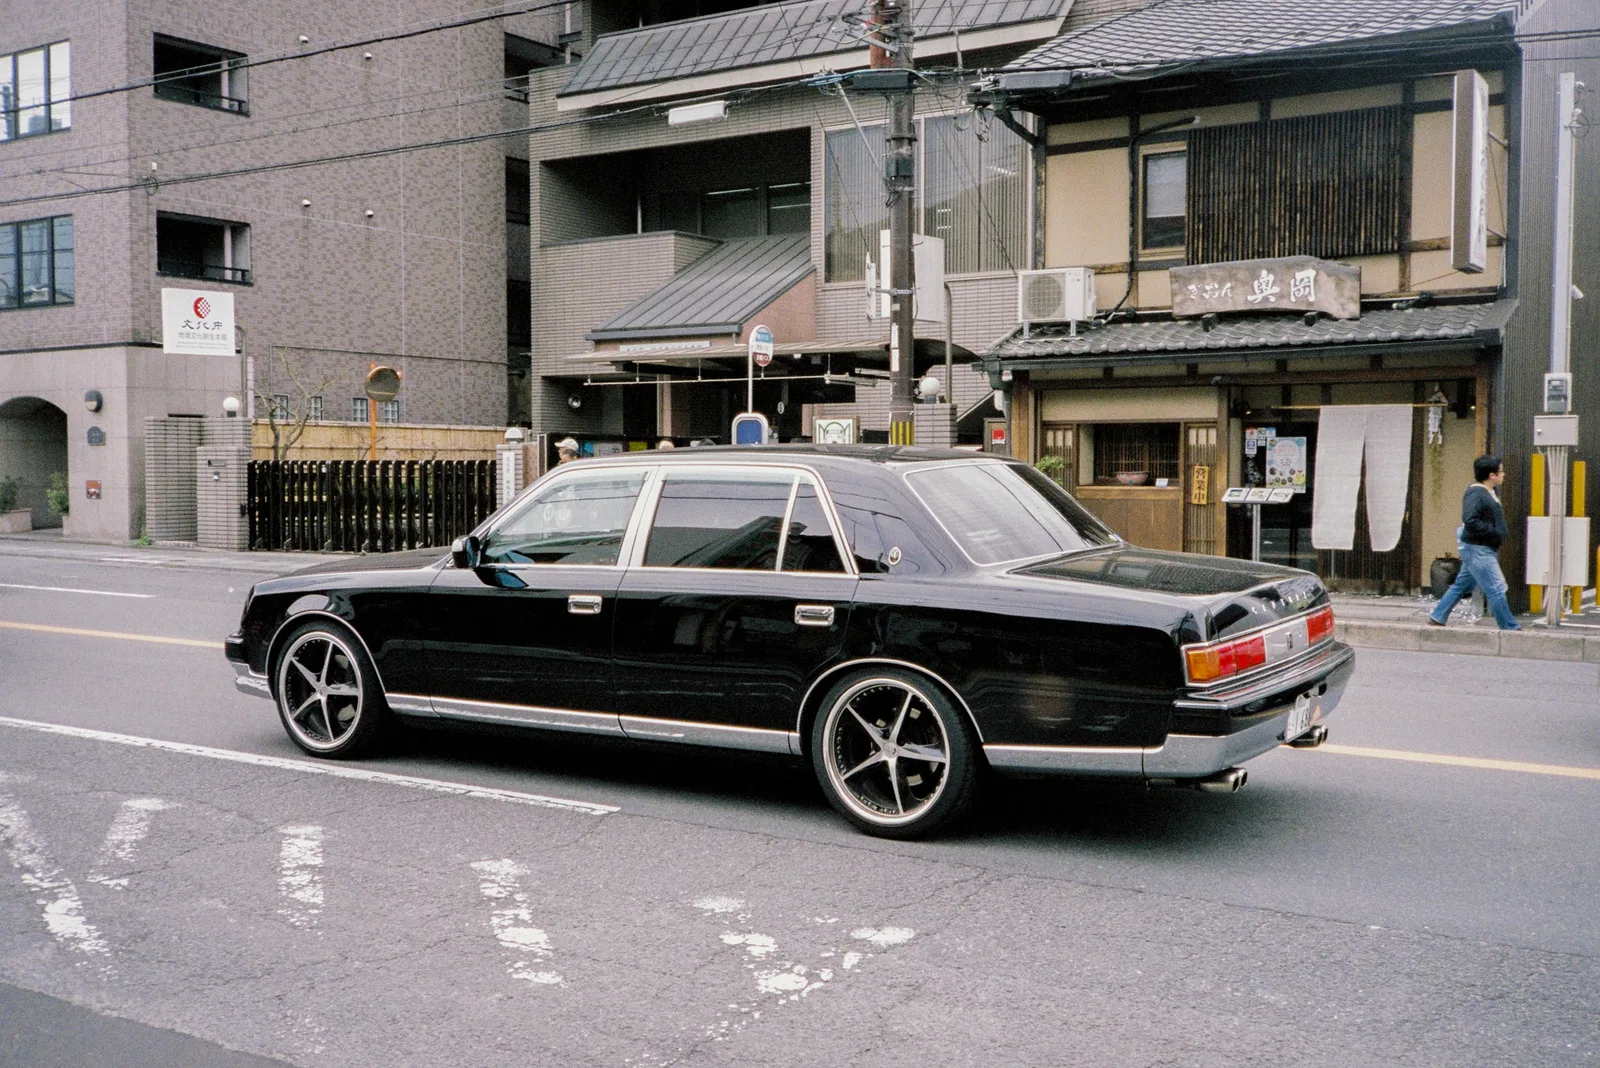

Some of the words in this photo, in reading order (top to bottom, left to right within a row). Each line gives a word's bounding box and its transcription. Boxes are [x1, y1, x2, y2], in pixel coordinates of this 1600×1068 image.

[1187, 282, 1233, 299] ぎおん
[182, 319, 223, 330] 文化庁
[1194, 467, 1207, 503] 営業中
